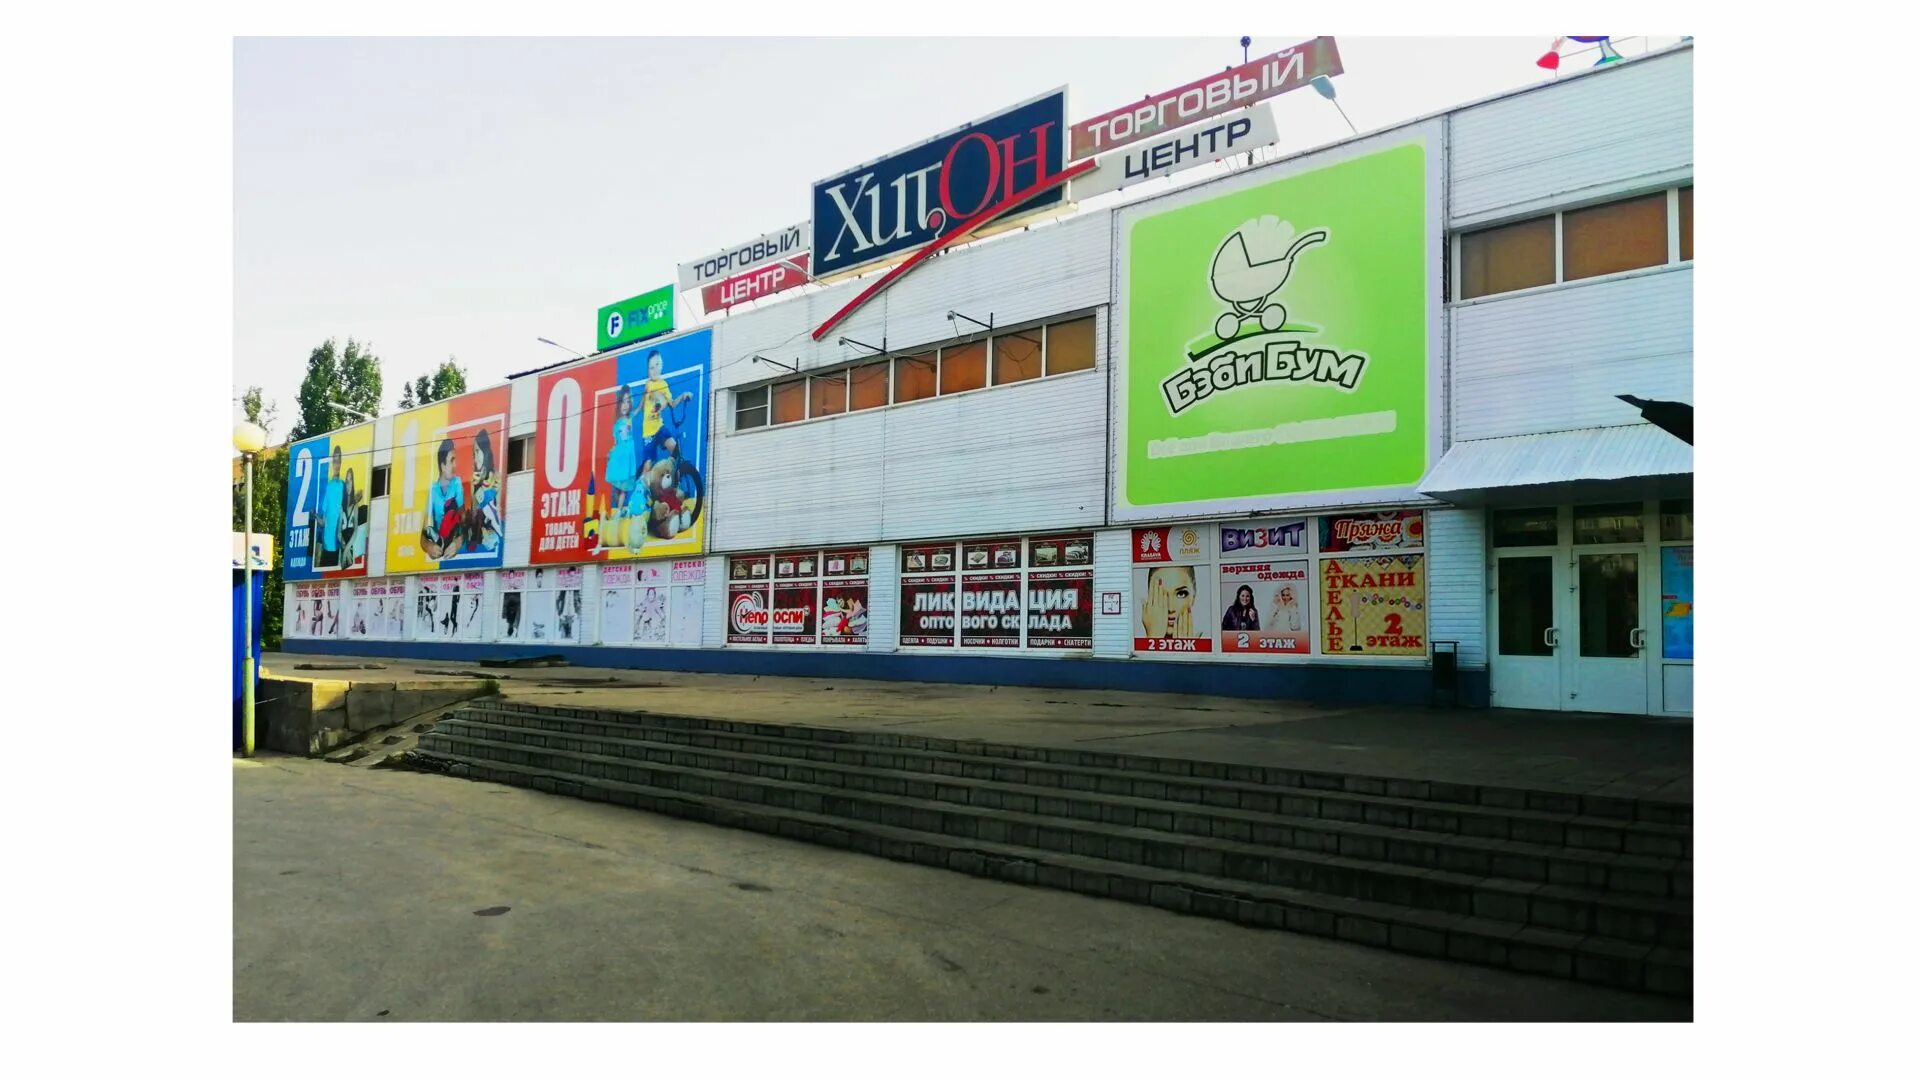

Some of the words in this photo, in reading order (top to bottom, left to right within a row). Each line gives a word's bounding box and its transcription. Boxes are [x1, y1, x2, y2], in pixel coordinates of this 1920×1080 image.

[1088, 48, 1305, 147] ТОРГОВЫЙ
[1125, 117, 1251, 179] ЦЕНТР
[693, 226, 800, 281] ТОРГОВЫЙ
[721, 267, 786, 304] ЦЕНТР
[1163, 351, 1264, 414] Бэби
[1265, 340, 1365, 389] Бум
[401, 419, 419, 510] 1
[292, 447, 313, 527] 2
[541, 489, 582, 519] ЭТАЖ
[289, 528, 310, 548] ЭТАЖ
[545, 520, 576, 536] ТОВАРЫ
[1335, 519, 1402, 544] Пряжа
[555, 533, 580, 550] ДЕТЕЙ
[1222, 564, 1271, 575] верхняя
[1257, 569, 1305, 580] одежда
[913, 588, 1079, 614] ЛИКВИДАЦИЯ
[1001, 615, 1073, 631] СКЛАДА
[1384, 613, 1403, 635] 2
[1148, 640, 1156, 650] 2
[1237, 632, 1249, 648] 2
